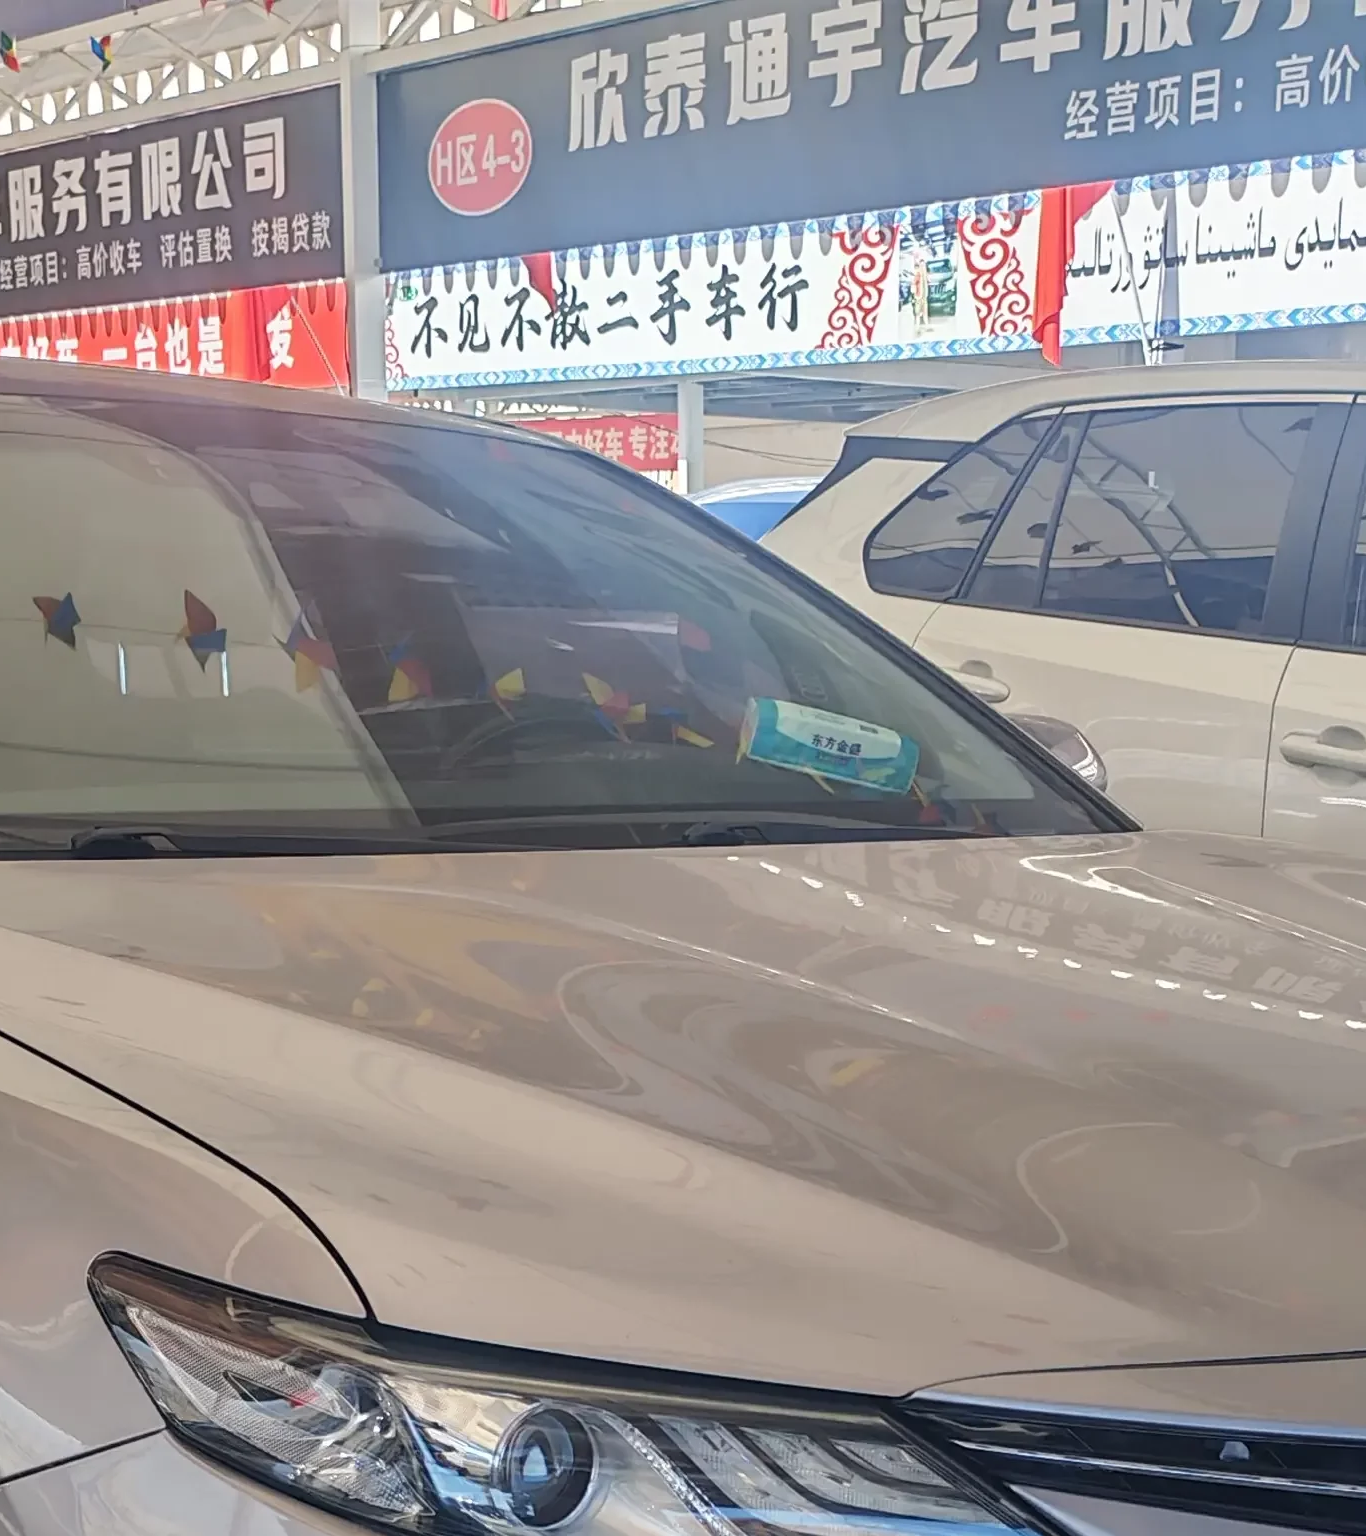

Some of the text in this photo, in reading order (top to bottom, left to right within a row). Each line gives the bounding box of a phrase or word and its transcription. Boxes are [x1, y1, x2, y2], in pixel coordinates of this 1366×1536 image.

[435, 126, 526, 188] H区4-3
[159, 224, 233, 270] 评估置换
[251, 210, 332, 257] 按揭贷款
[410, 263, 810, 359] 不见不散二手车行
